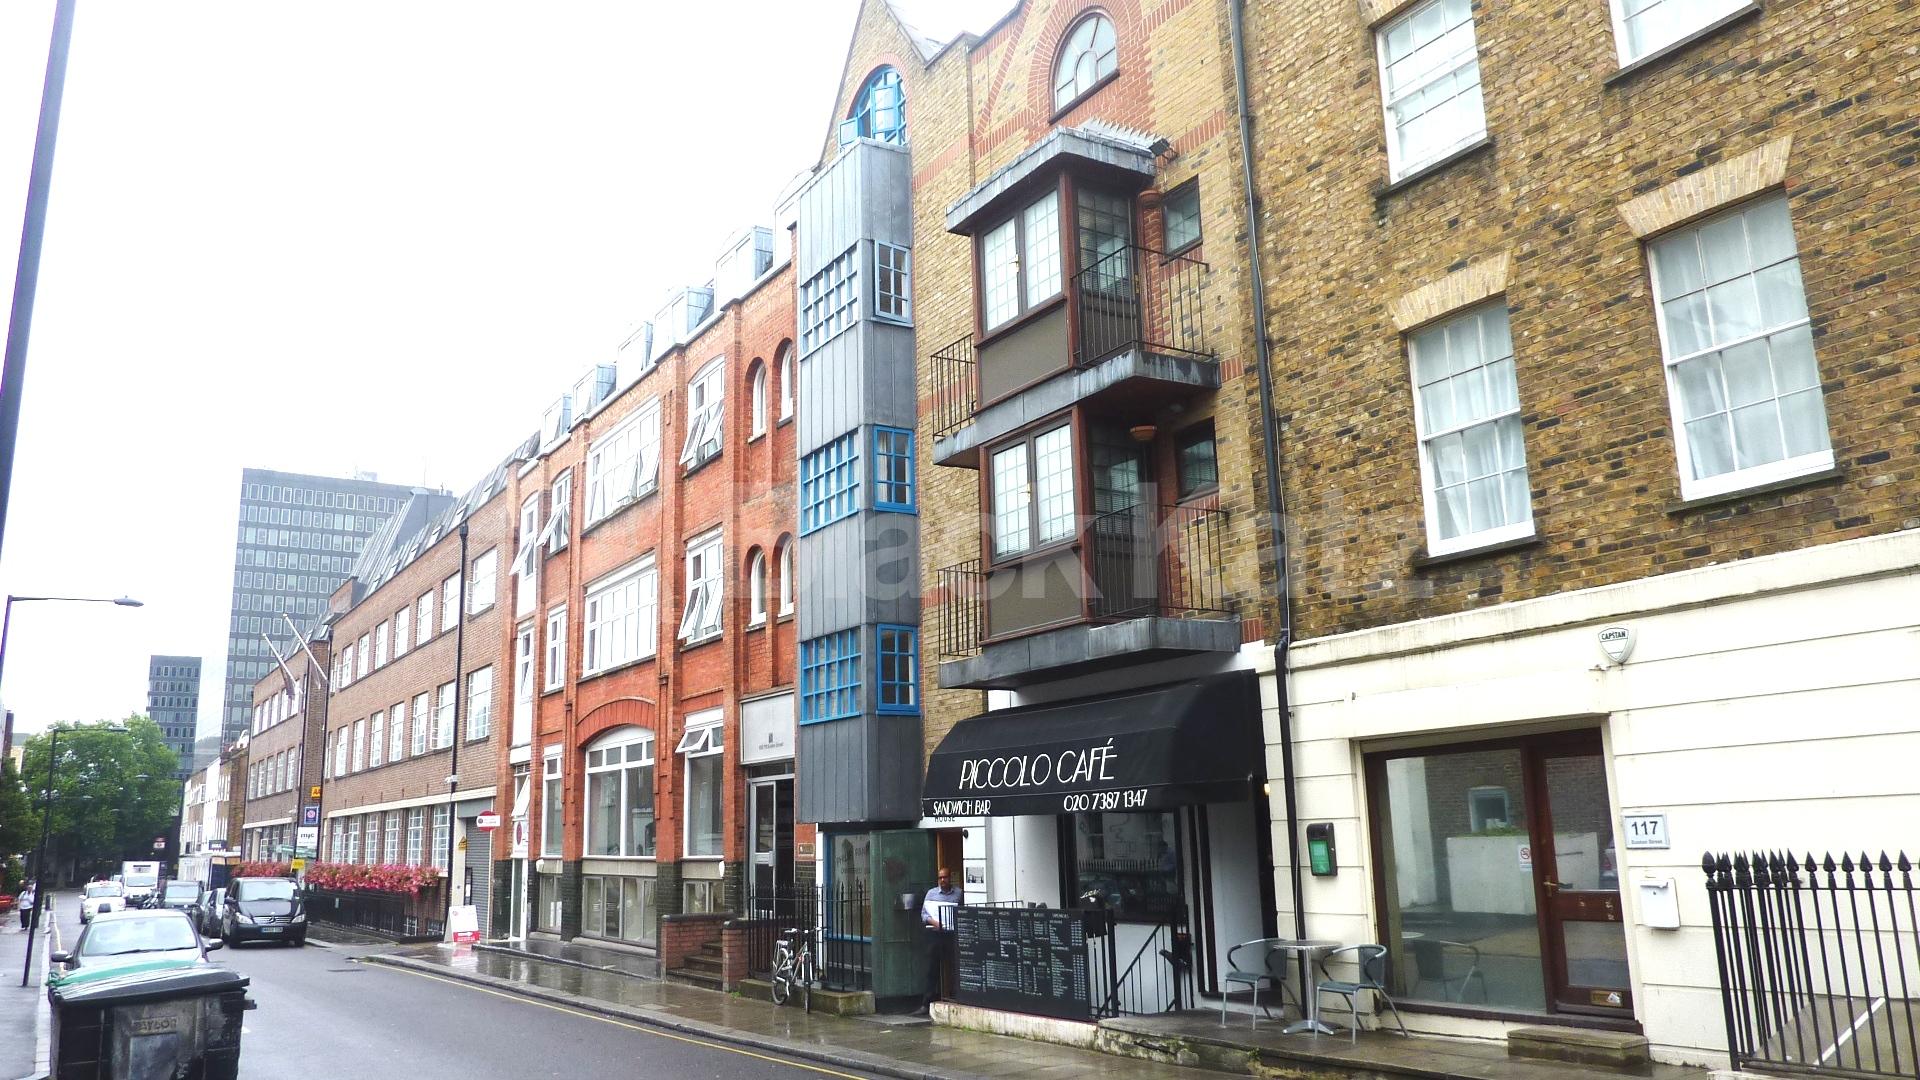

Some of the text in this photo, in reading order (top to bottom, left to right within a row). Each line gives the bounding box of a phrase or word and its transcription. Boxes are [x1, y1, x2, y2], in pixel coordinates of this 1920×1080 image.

[1601, 631, 1626, 640] CAPSTAN
[958, 738, 1118, 790] PICCOLO CAFÉ
[932, 799, 992, 815] SANDWICH BAR
[1063, 788, 1148, 812] 020 7387 1347
[1631, 820, 1659, 836] 117
